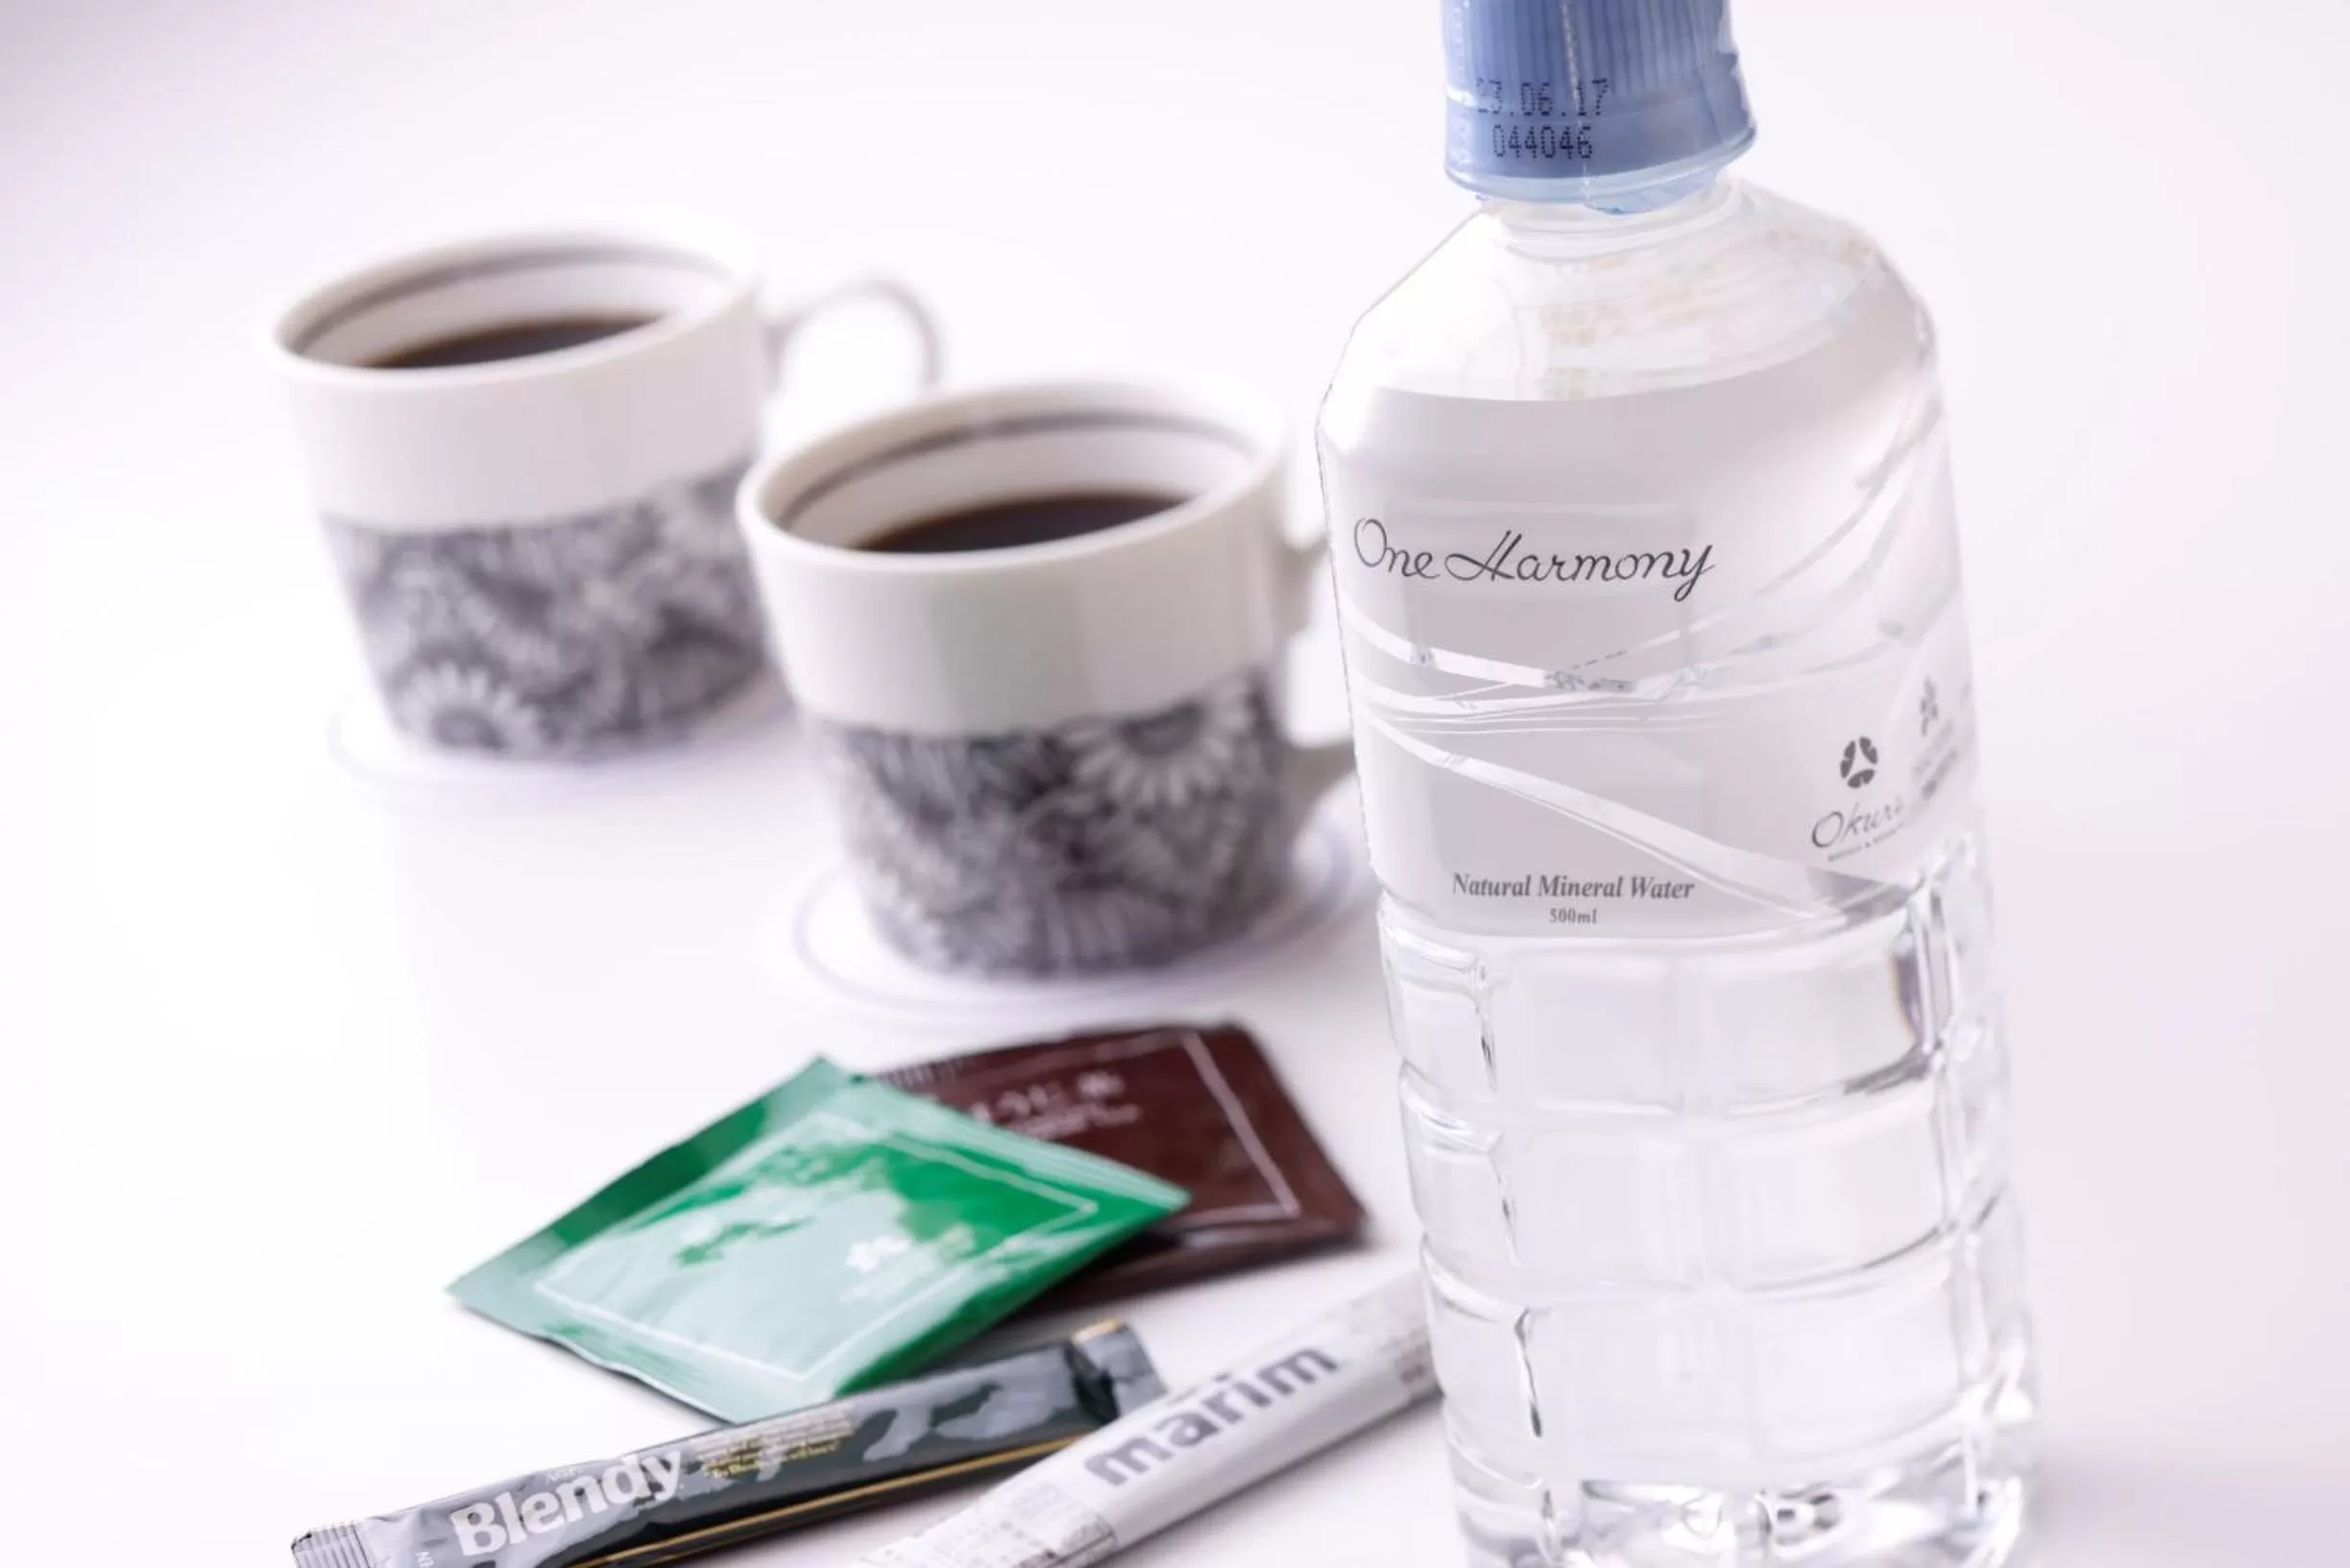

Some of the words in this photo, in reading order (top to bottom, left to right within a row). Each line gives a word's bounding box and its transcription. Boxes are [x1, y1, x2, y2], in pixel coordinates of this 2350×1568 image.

[1492, 124, 1592, 159] 044046
[1354, 518, 1440, 579] One
[1444, 530, 1714, 602] Harmony
[1452, 872, 1532, 898] Natural
[1538, 874, 1623, 898] Mineral
[1631, 876, 1694, 900] Water
[1549, 908, 1598, 925] 500ml
[449, 1451, 683, 1556] Blendy
